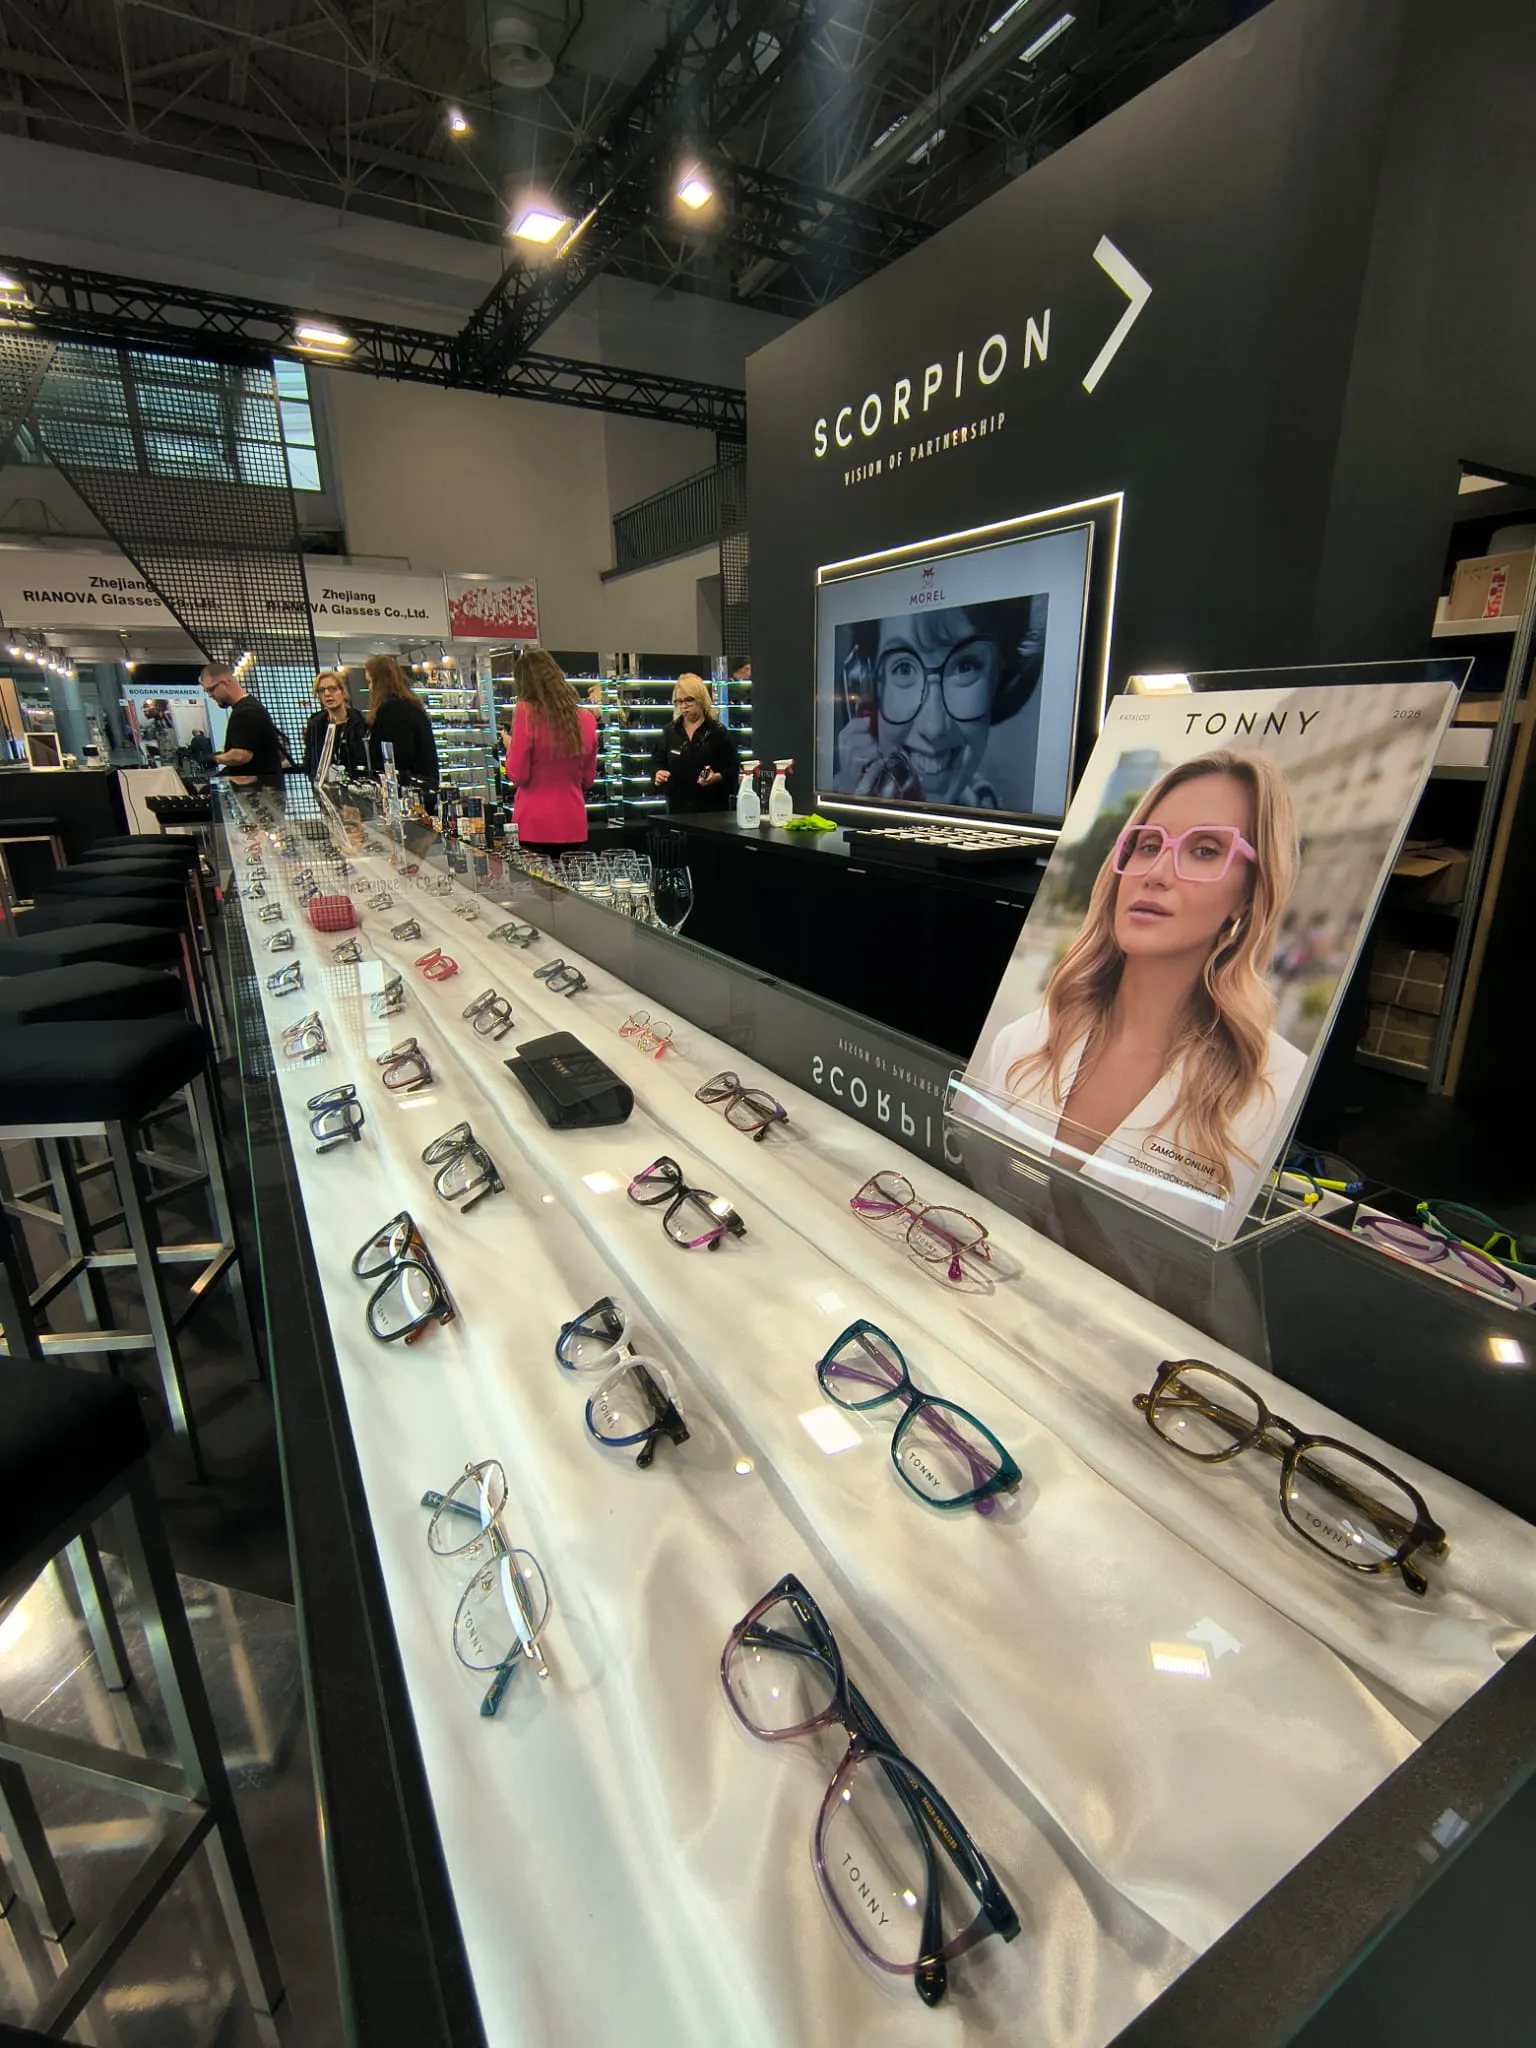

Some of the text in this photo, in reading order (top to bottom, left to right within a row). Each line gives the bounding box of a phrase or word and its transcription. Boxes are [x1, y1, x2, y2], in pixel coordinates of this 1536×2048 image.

[814, 308, 1051, 457] SCORPION
[844, 412, 1006, 486] VISION OF PARTNERSHIP
[23, 590, 97, 604] RIANOVA
[101, 593, 161, 607] Glasses
[322, 588, 376, 604] Zhejiang
[332, 604, 381, 617] Glasses
[384, 606, 430, 619] Co.,Ltd.
[909, 589, 945, 606] MOREL
[1185, 711, 1320, 736] TONNY
[1392, 709, 1422, 720] 2026
[1150, 1142, 1217, 1177] ZAMÓW ONLINE
[908, 1452, 941, 1488] TONNY
[1305, 1511, 1353, 1549] TONNY
[462, 1609, 484, 1655] TONNY
[841, 1852, 889, 1928] TONNY
